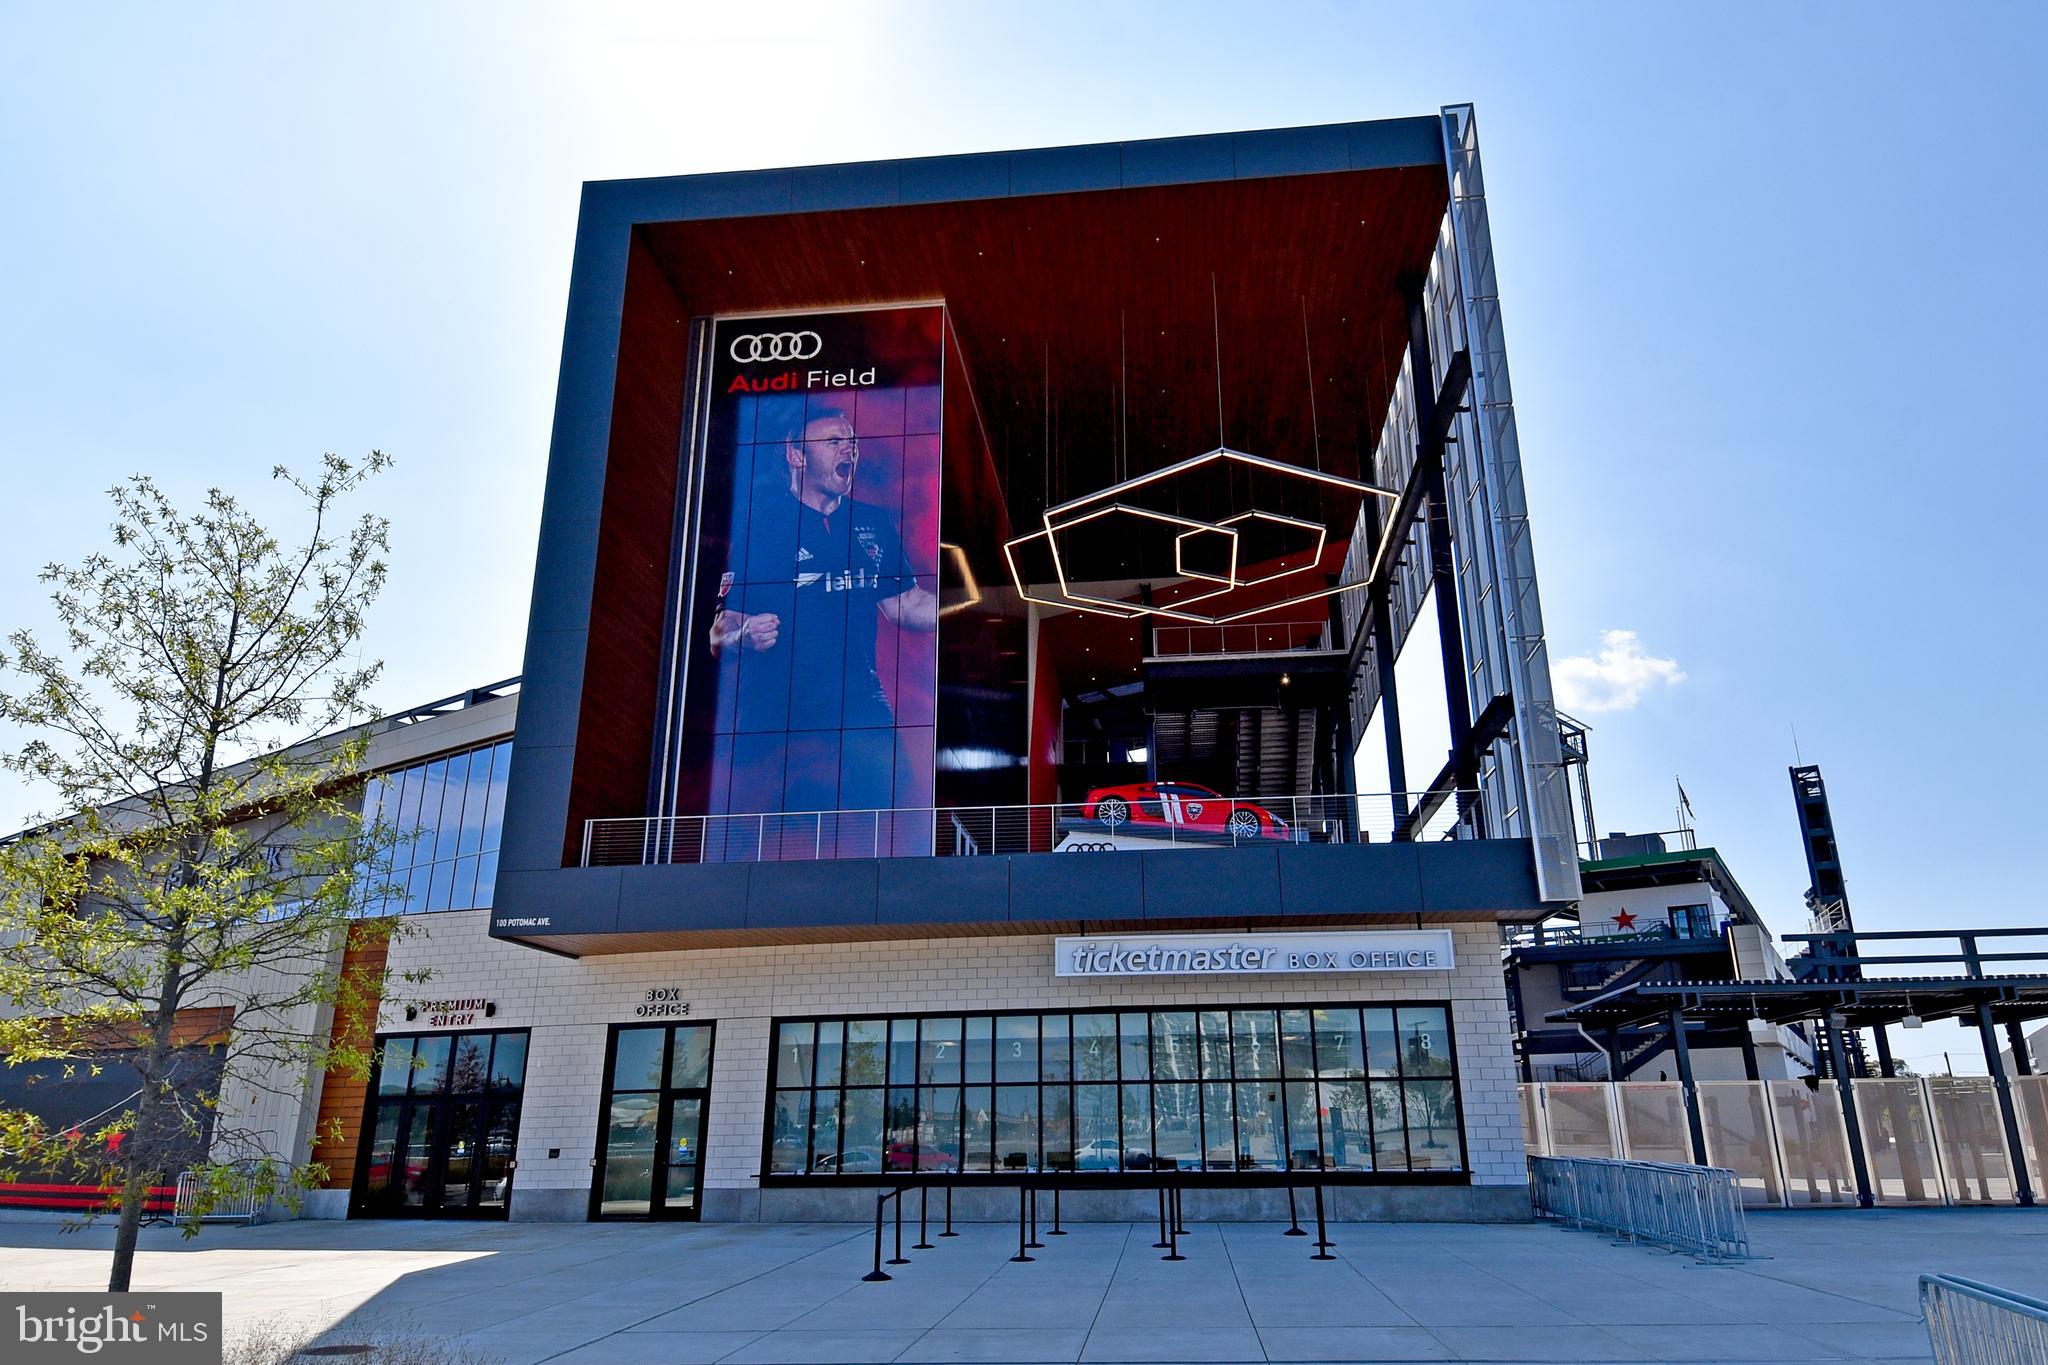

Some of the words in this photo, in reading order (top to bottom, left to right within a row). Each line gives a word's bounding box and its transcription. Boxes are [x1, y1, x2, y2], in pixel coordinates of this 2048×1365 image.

[728, 372, 798, 393] Audi
[807, 367, 876, 388] Field
[496, 919, 507, 927] 100
[508, 918, 537, 926] POTOMAC
[1072, 942, 1277, 973] ticketmaster
[1288, 952, 1338, 969] BOX
[1350, 950, 1438, 968] OFFICE
[646, 988, 679, 1001] BOX
[421, 999, 485, 1012] PREMIUM
[634, 1003, 689, 1017] OFFICE
[429, 1014, 474, 1026] ENTRY
[1089, 1040, 1100, 1056] 4
[1334, 1034, 1345, 1050] 7
[1421, 1033, 1431, 1049] 8
[792, 1047, 799, 1064] 1
[935, 1042, 945, 1059] 2
[1012, 1041, 1022, 1058] 3
